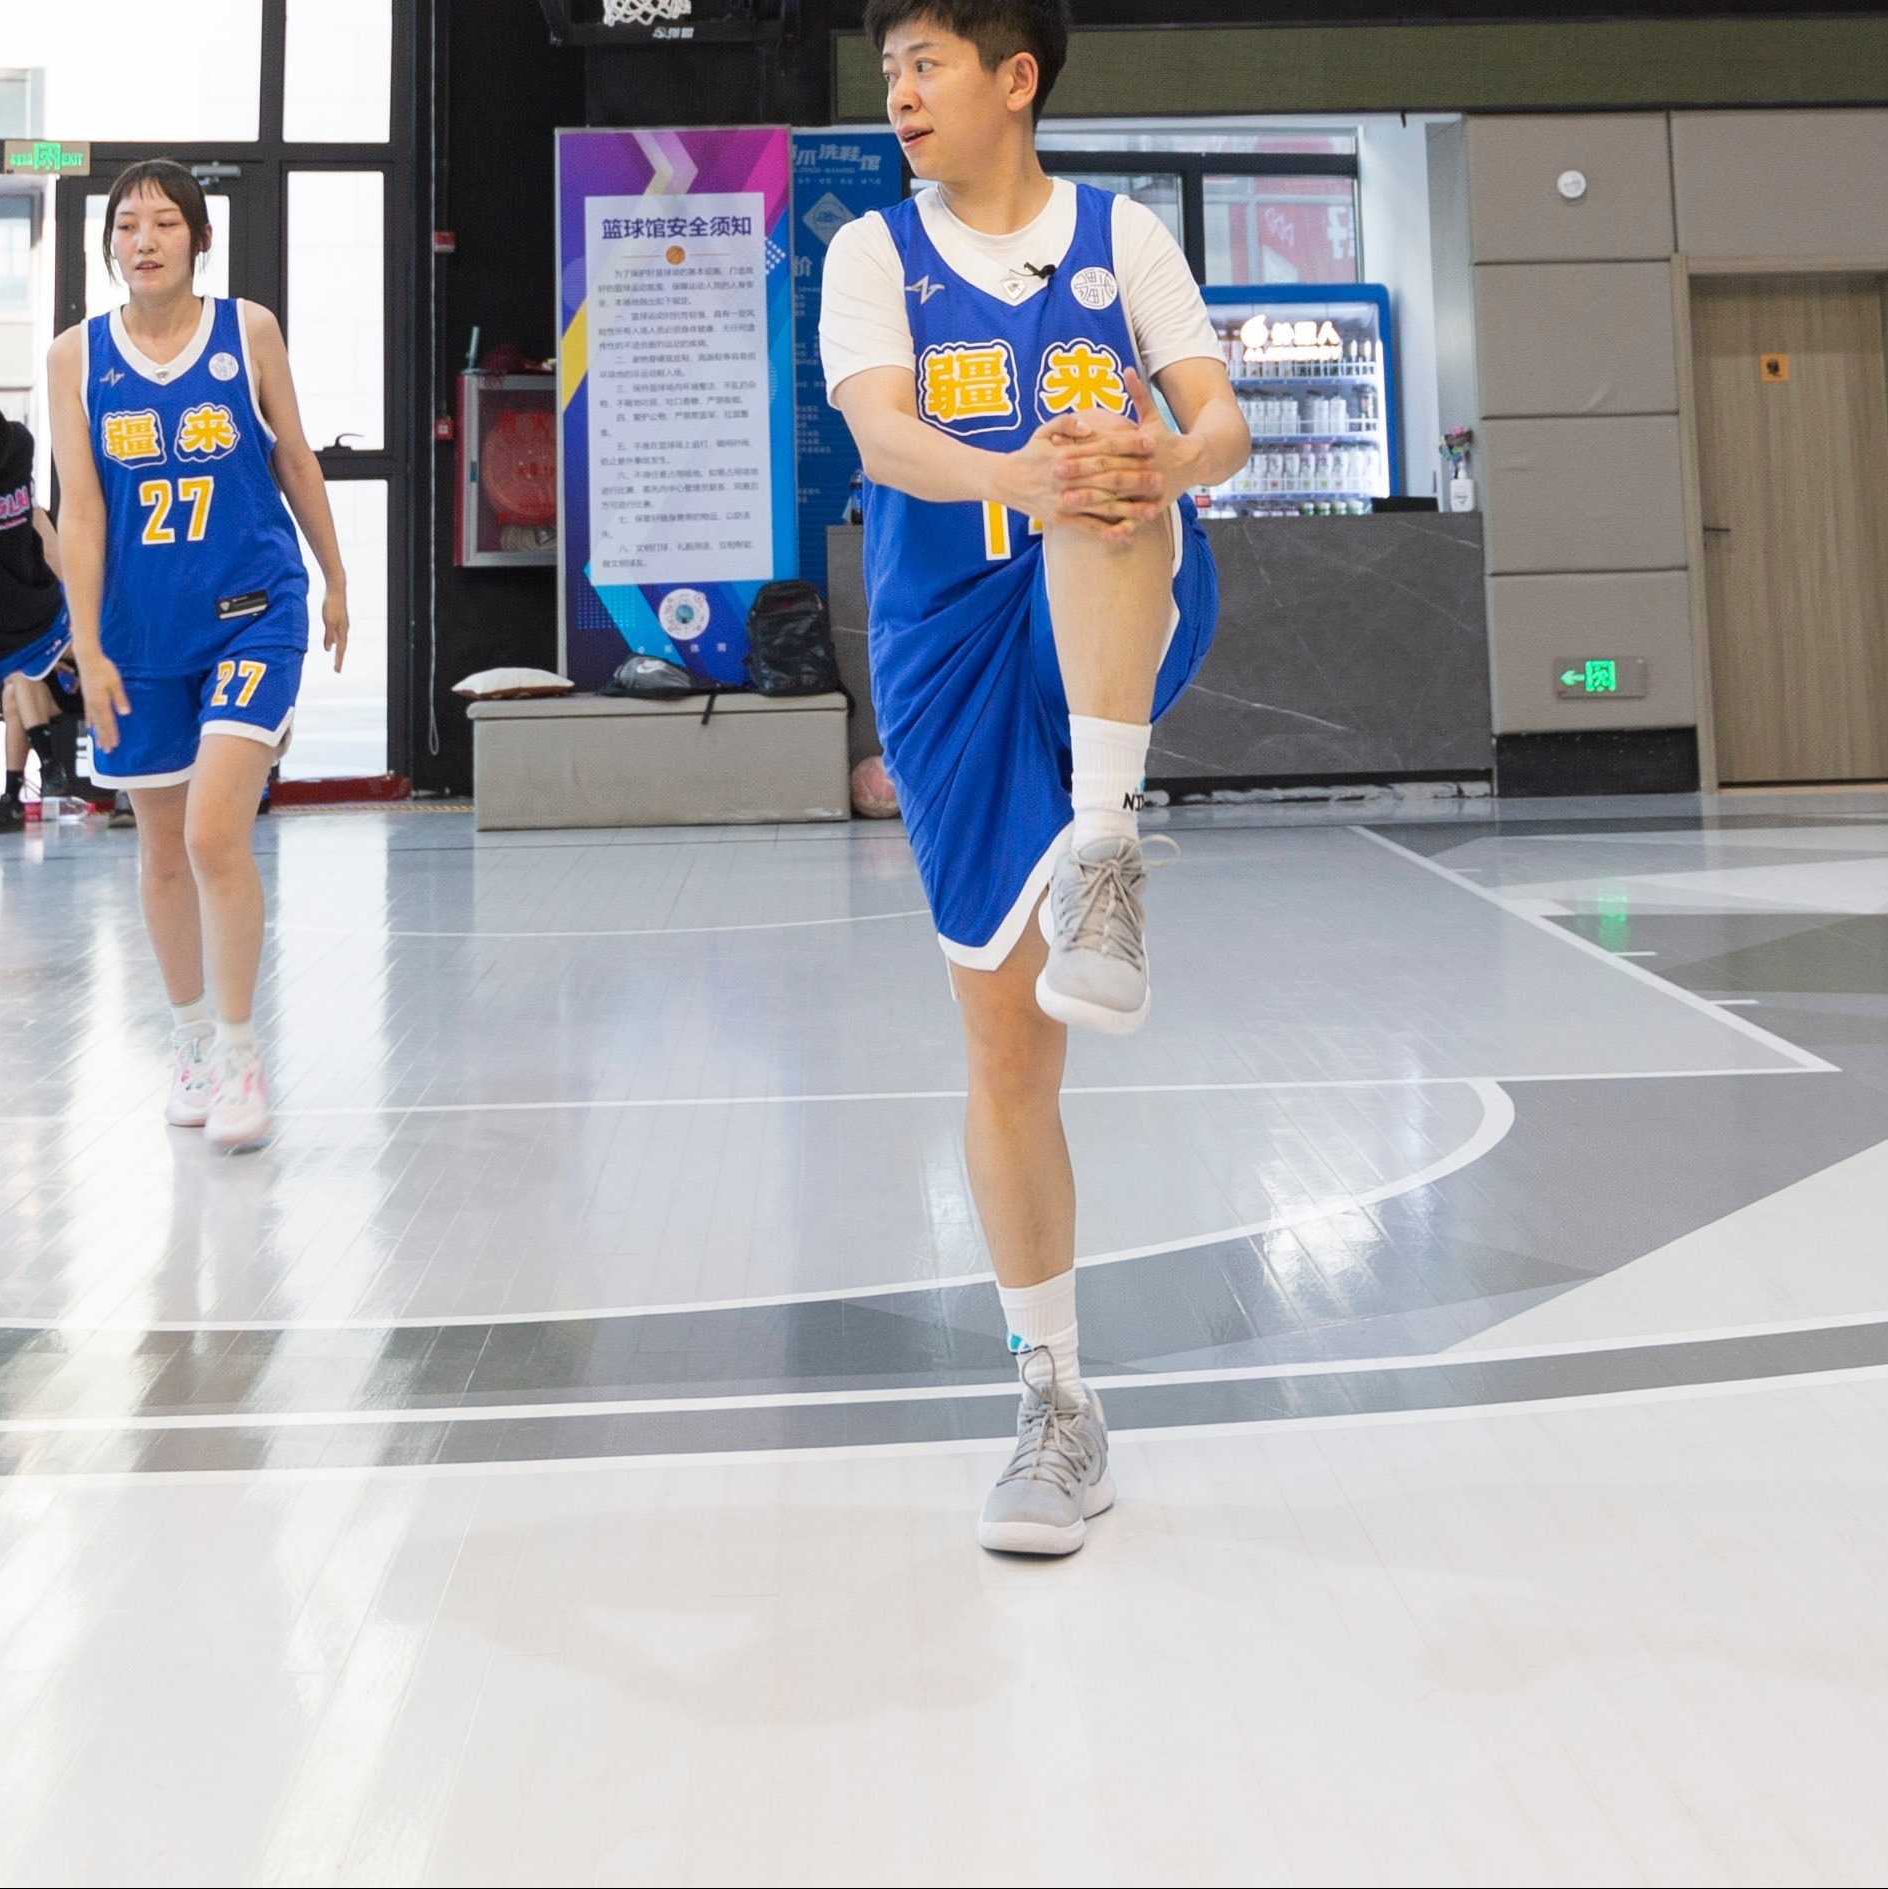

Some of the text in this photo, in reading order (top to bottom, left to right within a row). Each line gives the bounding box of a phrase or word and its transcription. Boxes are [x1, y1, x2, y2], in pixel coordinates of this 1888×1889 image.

[602, 216, 752, 239] 篮球馆安全须知
[139, 475, 215, 546] 27
[211, 659, 268, 708] 27
